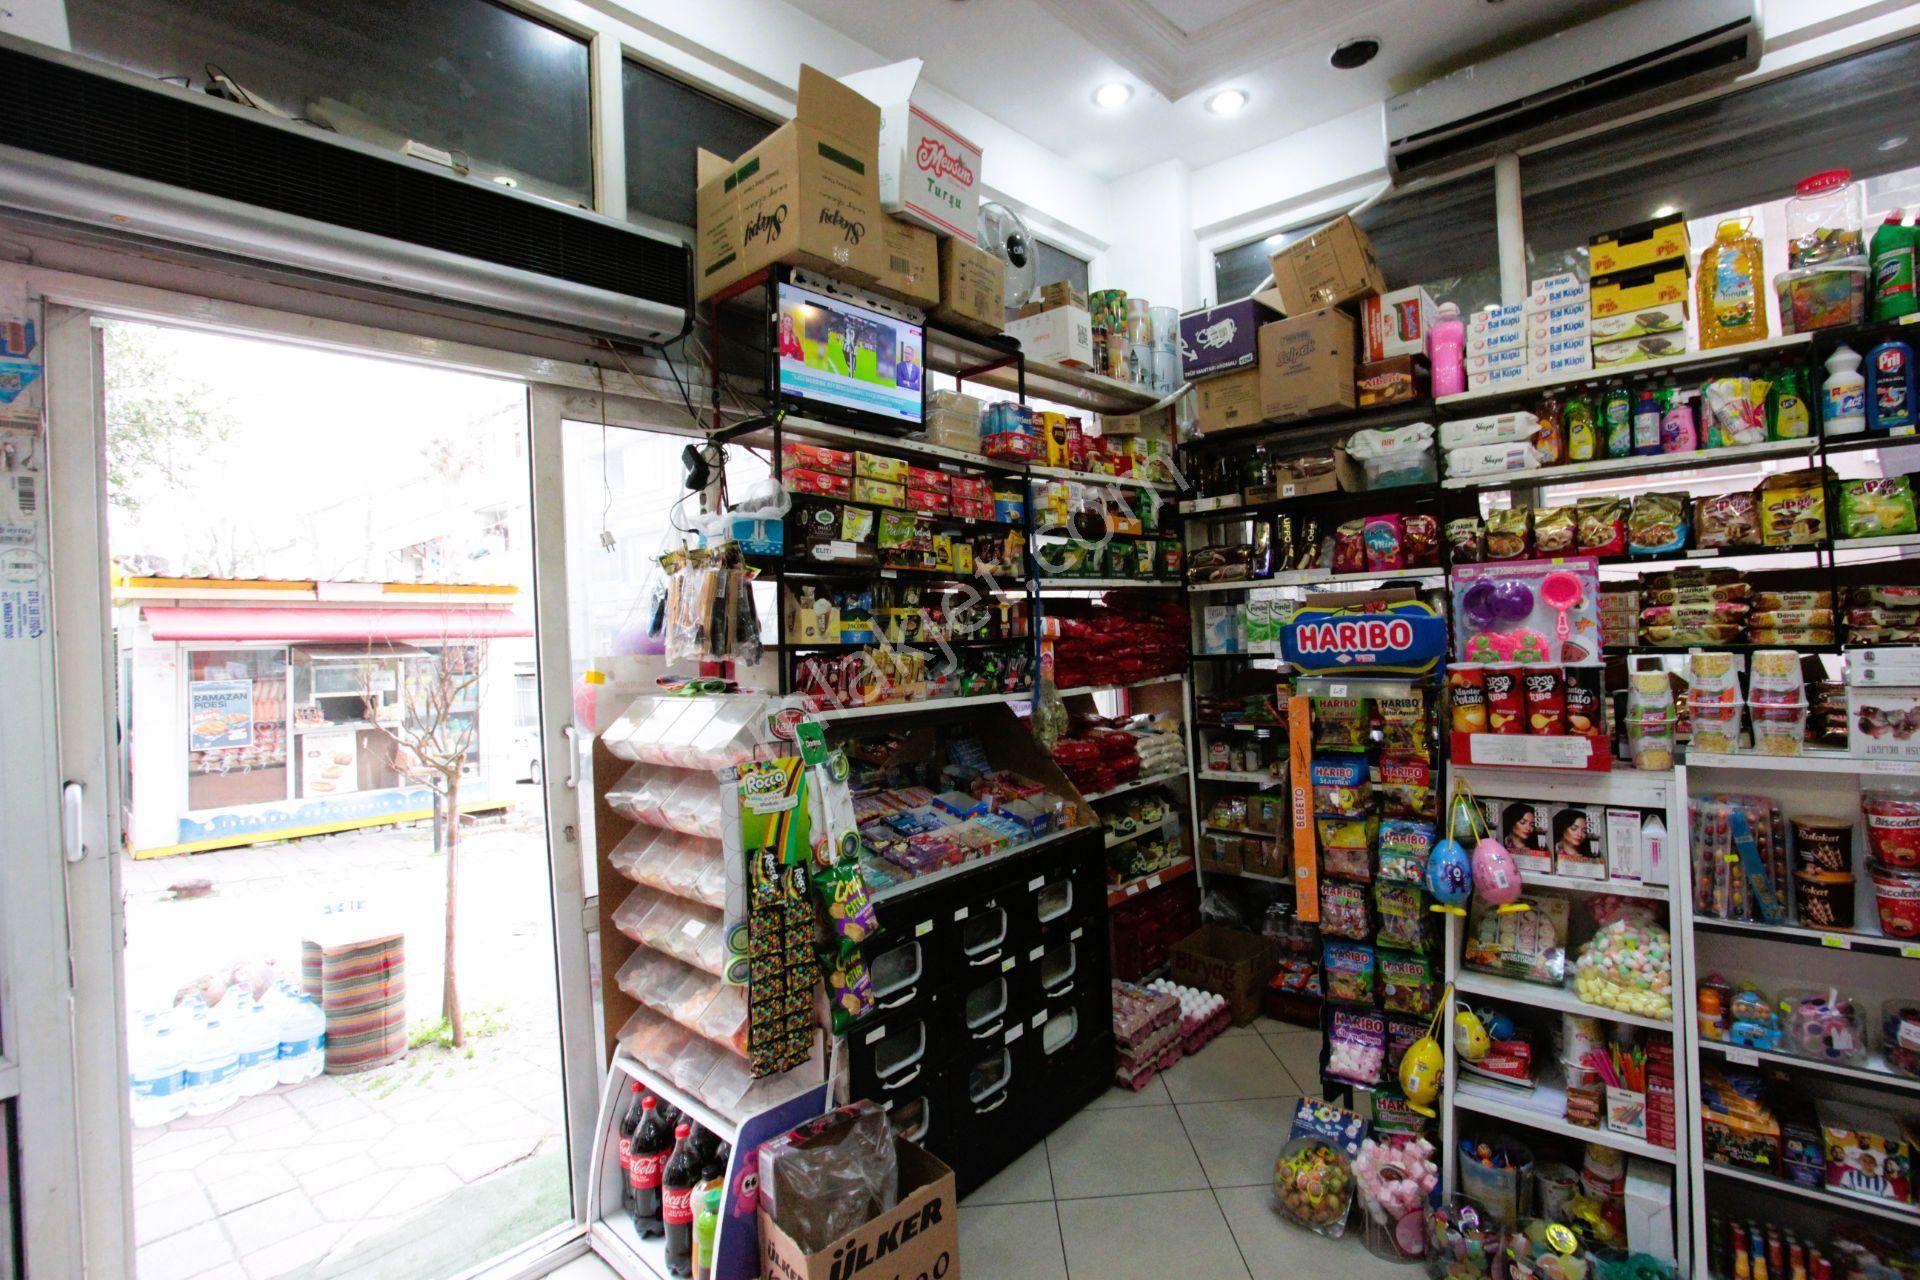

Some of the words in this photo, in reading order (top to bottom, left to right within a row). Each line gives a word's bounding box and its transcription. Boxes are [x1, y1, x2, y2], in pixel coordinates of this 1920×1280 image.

[744, 204, 787, 246] Sleepy
[819, 208, 865, 245] Sleepy
[1545, 280, 1554, 288] Bal
[1550, 291, 1561, 301] Bal
[1491, 310, 1502, 319] Bal
[1550, 310, 1561, 319] Bal
[1488, 321, 1498, 330] Bal
[1550, 326, 1561, 335] Bal
[1487, 337, 1499, 347] Bal
[1550, 342, 1561, 351] Bal
[1488, 354, 1499, 363] Bal
[1878, 352, 1901, 370] Pril
[1551, 360, 1562, 370] Bal
[1489, 371, 1500, 380] Bal
[1283, 517, 1292, 543] UPPO
[1297, 619, 1413, 653] HARIBO
[193, 692, 248, 703] RAMAZAN
[1382, 698, 1419, 708] HARIBO
[1320, 699, 1357, 708] HARIBO
[1315, 767, 1354, 777] HARIBO
[746, 770, 784, 793] Rocco
[1295, 788, 1306, 828] BEBETO
[1874, 817, 1920, 828] Biscolat
[1384, 832, 1427, 845] HARIBO
[1322, 886, 1361, 899] HARIBO
[1801, 887, 1829, 898] lokat
[1334, 1013, 1384, 1033] HARIBO
[1377, 1098, 1411, 1112] HARI
[829, 1197, 943, 1280] ÜLKER
